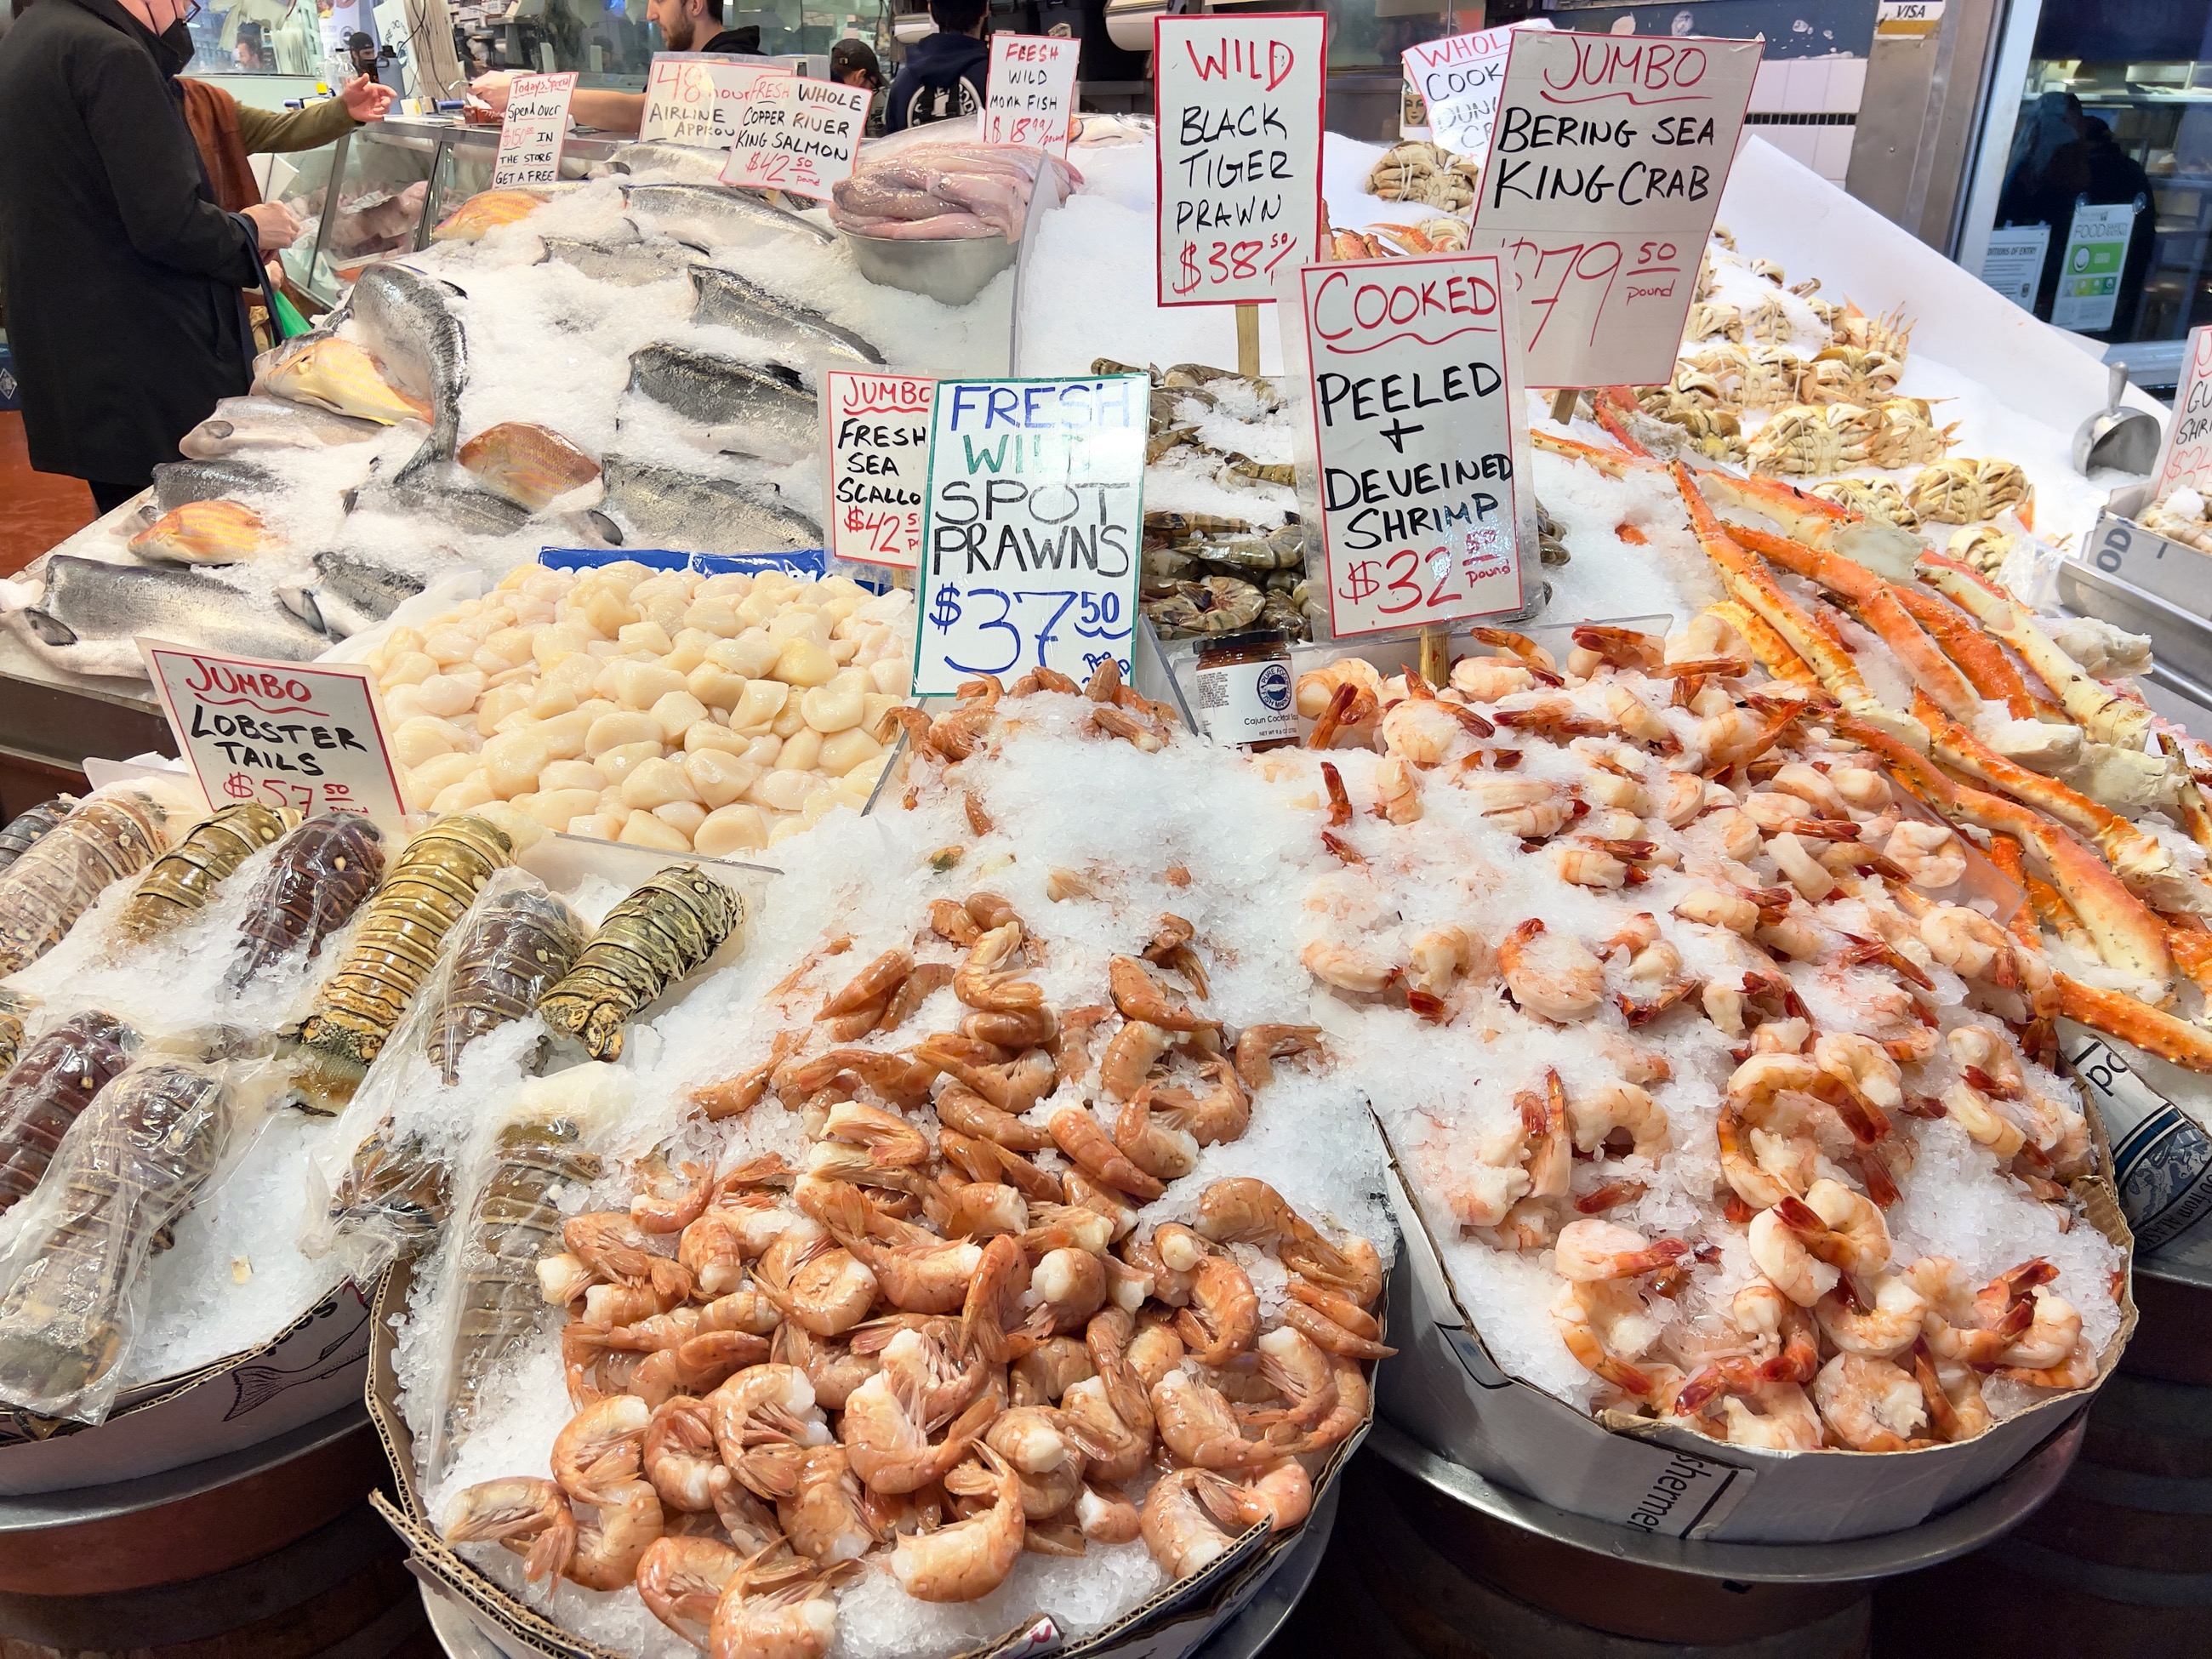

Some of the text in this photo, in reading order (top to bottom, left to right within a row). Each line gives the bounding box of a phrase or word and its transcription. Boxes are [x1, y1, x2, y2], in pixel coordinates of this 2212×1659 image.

[1897, 5, 1926, 18] VISA
[1006, 43, 1058, 62] FRESH
[1186, 37, 1295, 92] WILD
[1544, 37, 1707, 91] JUMBO
[658, 64, 702, 103] 48
[1009, 69, 1047, 85] WILD
[1427, 63, 1503, 101] COOK
[750, 79, 862, 111] FRESH WHOLE
[1027, 94, 1058, 111] FISH
[508, 102, 535, 123] Spend
[649, 103, 726, 123] AIRLINE
[743, 106, 784, 127] COPPER
[1180, 103, 1287, 145] BLACK
[536, 132, 553, 142] IN
[735, 129, 848, 162] KING SALMON
[1498, 106, 1714, 153] BERING SEA
[500, 152, 553, 164] THE STORE
[1179, 149, 1294, 189] TIGER
[495, 170, 555, 185] GET A FREE
[795, 175, 820, 186] pound
[1494, 158, 1709, 208] KING CRAB
[1177, 194, 1282, 235] PRAWN
[2074, 225, 2105, 238] FOOD
[1314, 271, 1497, 340] COOKED
[1627, 279, 1676, 305] pound
[951, 382, 1130, 431] FRESH
[1316, 362, 1502, 426] PEELED
[837, 418, 926, 449] FRESH
[1379, 418, 1424, 453] +
[847, 452, 899, 476] SEA
[836, 477, 921, 505] SCALLO
[936, 480, 1130, 526] SPOT
[1344, 493, 1499, 550] SHRIMP
[933, 522, 1129, 577] PRAWNS
[1465, 559, 1511, 589] pound
[185, 658, 312, 702] JUMBO
[1261, 668, 1275, 684] PURE
[1261, 691, 1274, 706] FISH
[191, 704, 368, 752] LOBSTER
[1244, 716, 1266, 726] Cajun
[214, 741, 324, 776] TAILS
